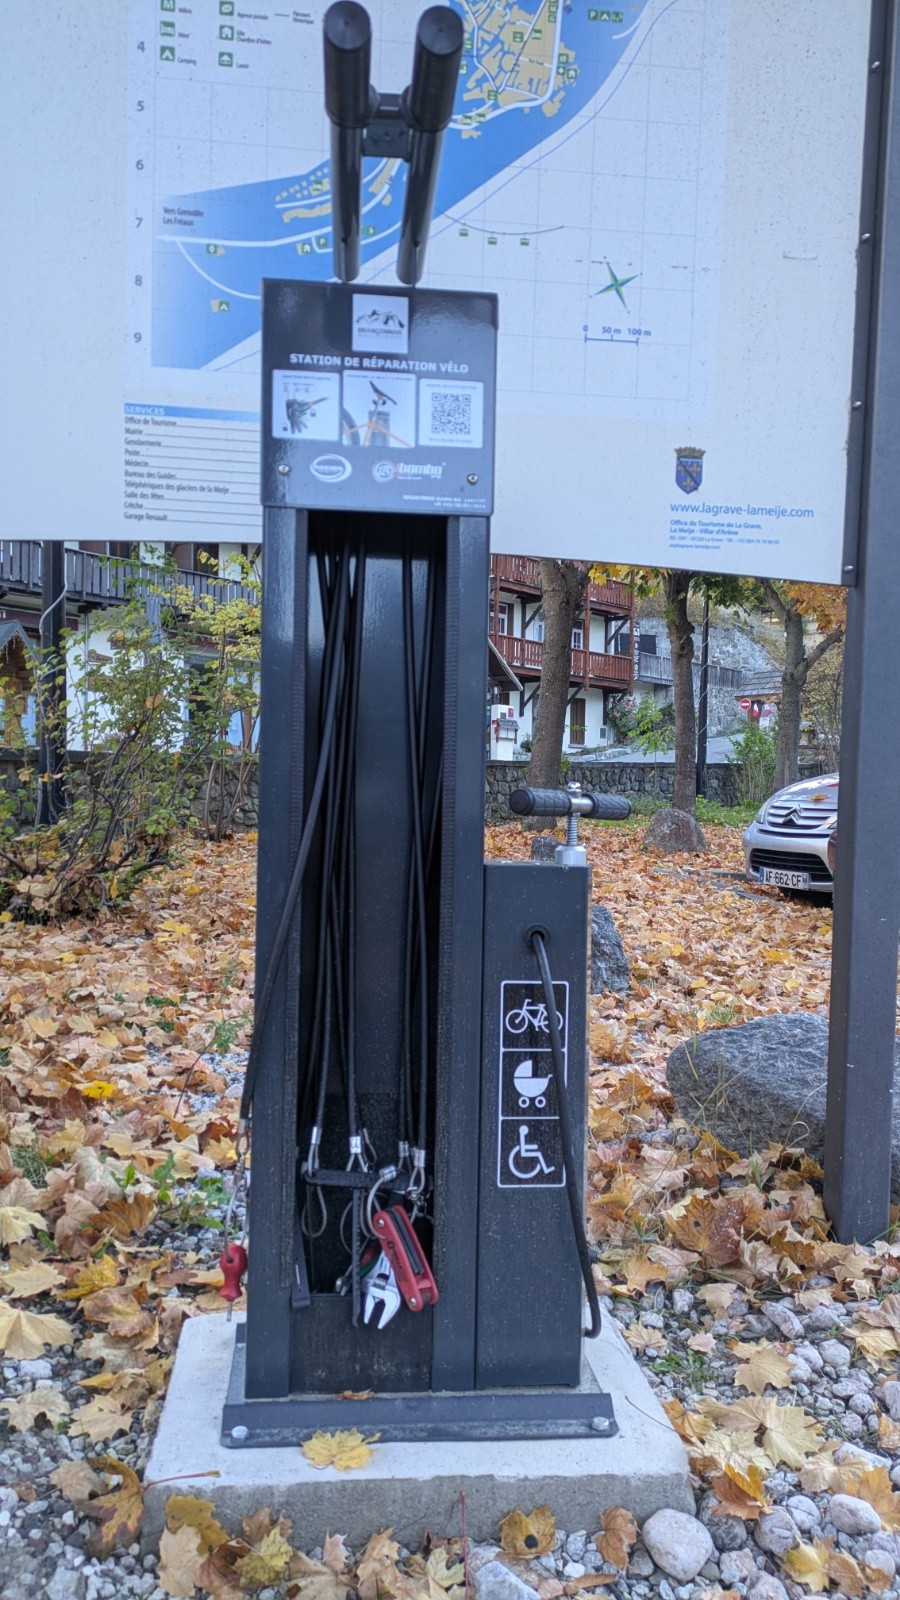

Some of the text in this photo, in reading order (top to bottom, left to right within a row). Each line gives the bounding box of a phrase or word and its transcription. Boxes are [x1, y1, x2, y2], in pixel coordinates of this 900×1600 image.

[137, 41, 146, 52] 4
[178, 57, 196, 66] Camping
[136, 101, 145, 112] 5
[135, 159, 144, 170] 6
[163, 207, 204, 218] Vers Grenoble
[135, 217, 143, 228] 7
[162, 216, 194, 227] Les Fréaux
[134, 274, 143, 286] 8
[582, 324, 588, 332] 0
[602, 326, 612, 334] 50
[628, 328, 642, 336] 100
[134, 332, 142, 344] 9
[289, 353, 469, 373] STATION DE RÉPARATION VÉLO
[124, 404, 165, 415] SERVICES
[124, 416, 176, 426] Office de Tourisme
[124, 427, 143, 436] Mairie
[124, 438, 162, 447] Gendarmerie
[124, 448, 140, 456] Poste
[124, 459, 149, 467] Médecin
[124, 470, 176, 480] Bureau des Guides
[124, 480, 230, 495] Téléphériques des glaciers de la Meije
[124, 490, 164, 500] Salle des fêtes
[124, 501, 144, 510] Crèche
[670, 502, 814, 520] www.lagrave-lameije.com
[124, 511, 168, 522] Garage Renault
